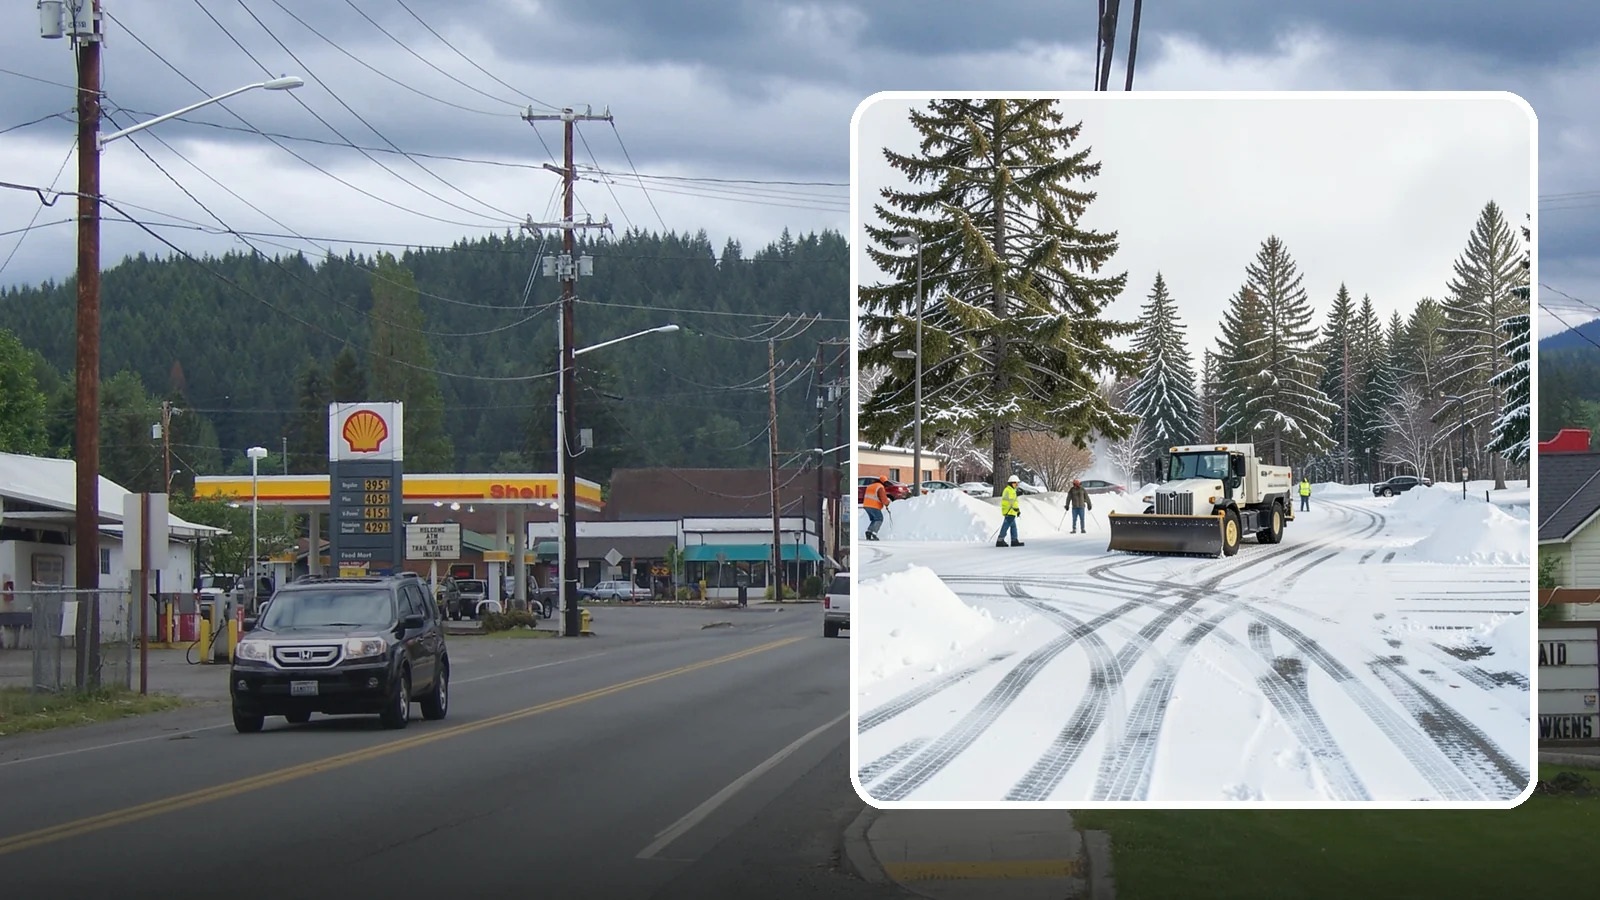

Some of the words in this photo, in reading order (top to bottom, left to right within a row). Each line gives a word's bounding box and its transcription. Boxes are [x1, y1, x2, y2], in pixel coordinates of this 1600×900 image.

[365, 480, 384, 490] 395
[490, 484, 547, 499] Shell
[365, 494, 384, 504] 405
[365, 508, 383, 518] 415
[365, 522, 384, 533] 429
